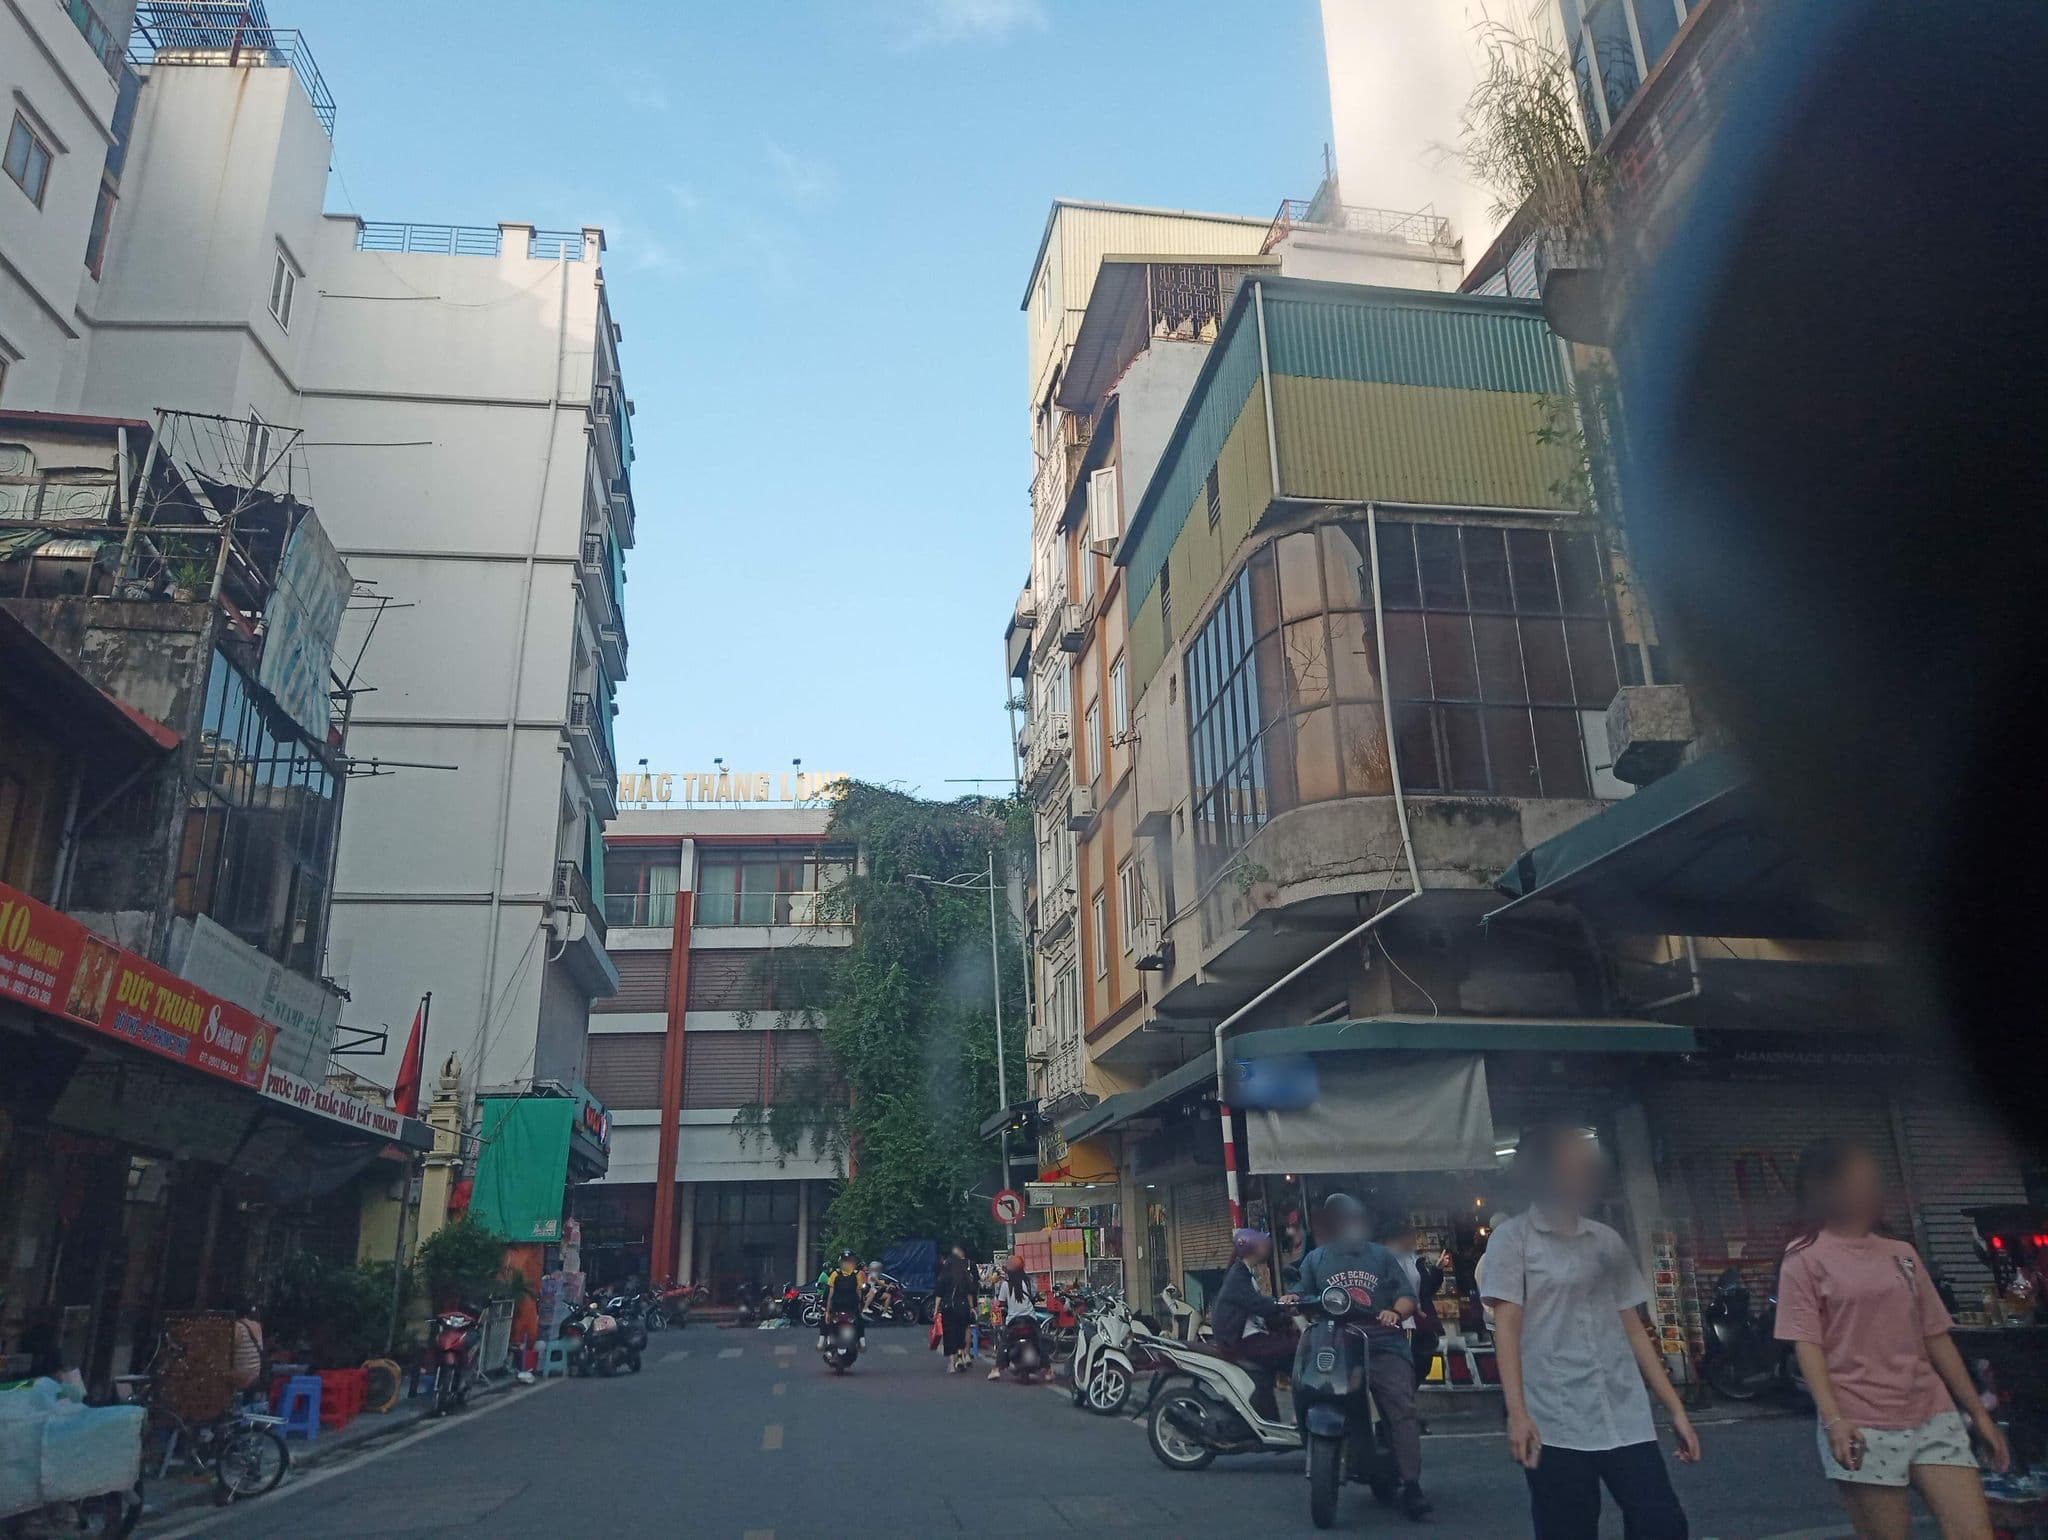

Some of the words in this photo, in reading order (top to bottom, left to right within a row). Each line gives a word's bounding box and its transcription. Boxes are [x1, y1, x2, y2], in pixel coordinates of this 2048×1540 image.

[683, 765, 770, 802] THĂNG
[115, 969, 155, 1013] ĐỨC
[203, 1004, 222, 1044] 8
[1326, 1272, 1347, 1287] LIFE
[1347, 1270, 1379, 1286] SCHOOL
